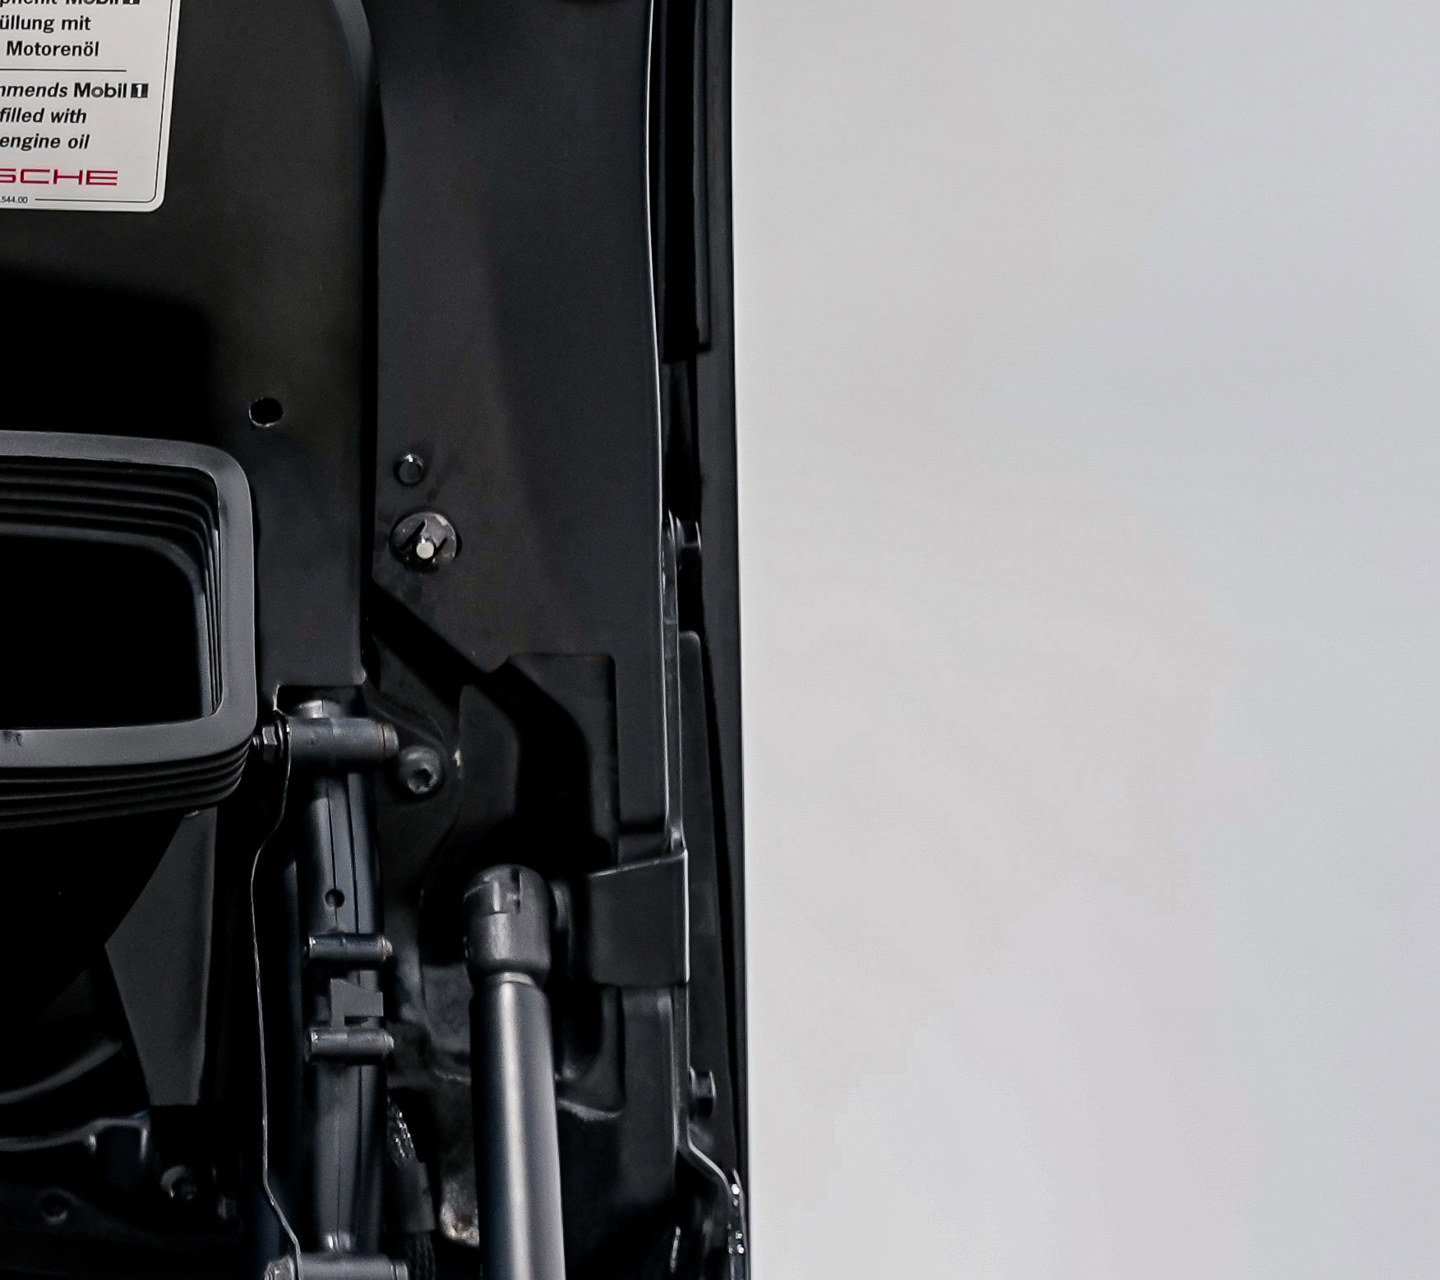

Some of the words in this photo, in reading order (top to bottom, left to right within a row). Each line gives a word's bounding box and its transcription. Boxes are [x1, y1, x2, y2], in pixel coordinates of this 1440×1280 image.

[61, 15, 92, 31] mit
[6, 41, 100, 57] Motorenöl
[0, 107, 45, 123] filled
[50, 108, 87, 123] with
[0, 135, 60, 151] engine
[67, 134, 90, 149] oil
